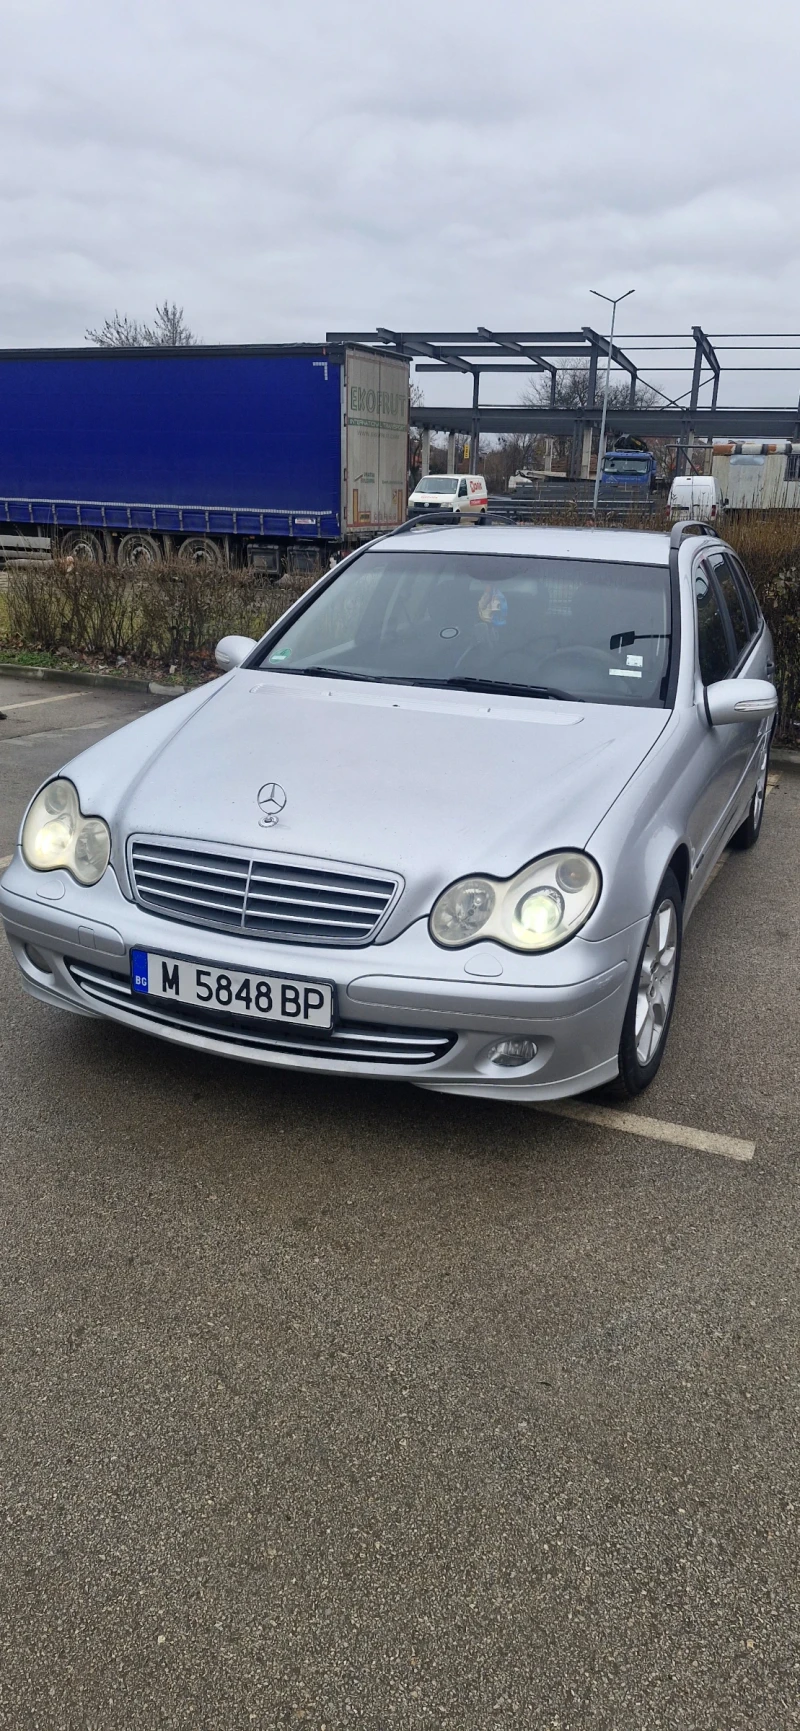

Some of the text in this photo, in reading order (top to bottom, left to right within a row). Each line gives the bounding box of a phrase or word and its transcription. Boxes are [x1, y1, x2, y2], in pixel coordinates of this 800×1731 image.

[350, 386, 406, 417] EKOFRUT
[135, 975, 147, 987] BG
[161, 961, 325, 1020] M 5848 BP
